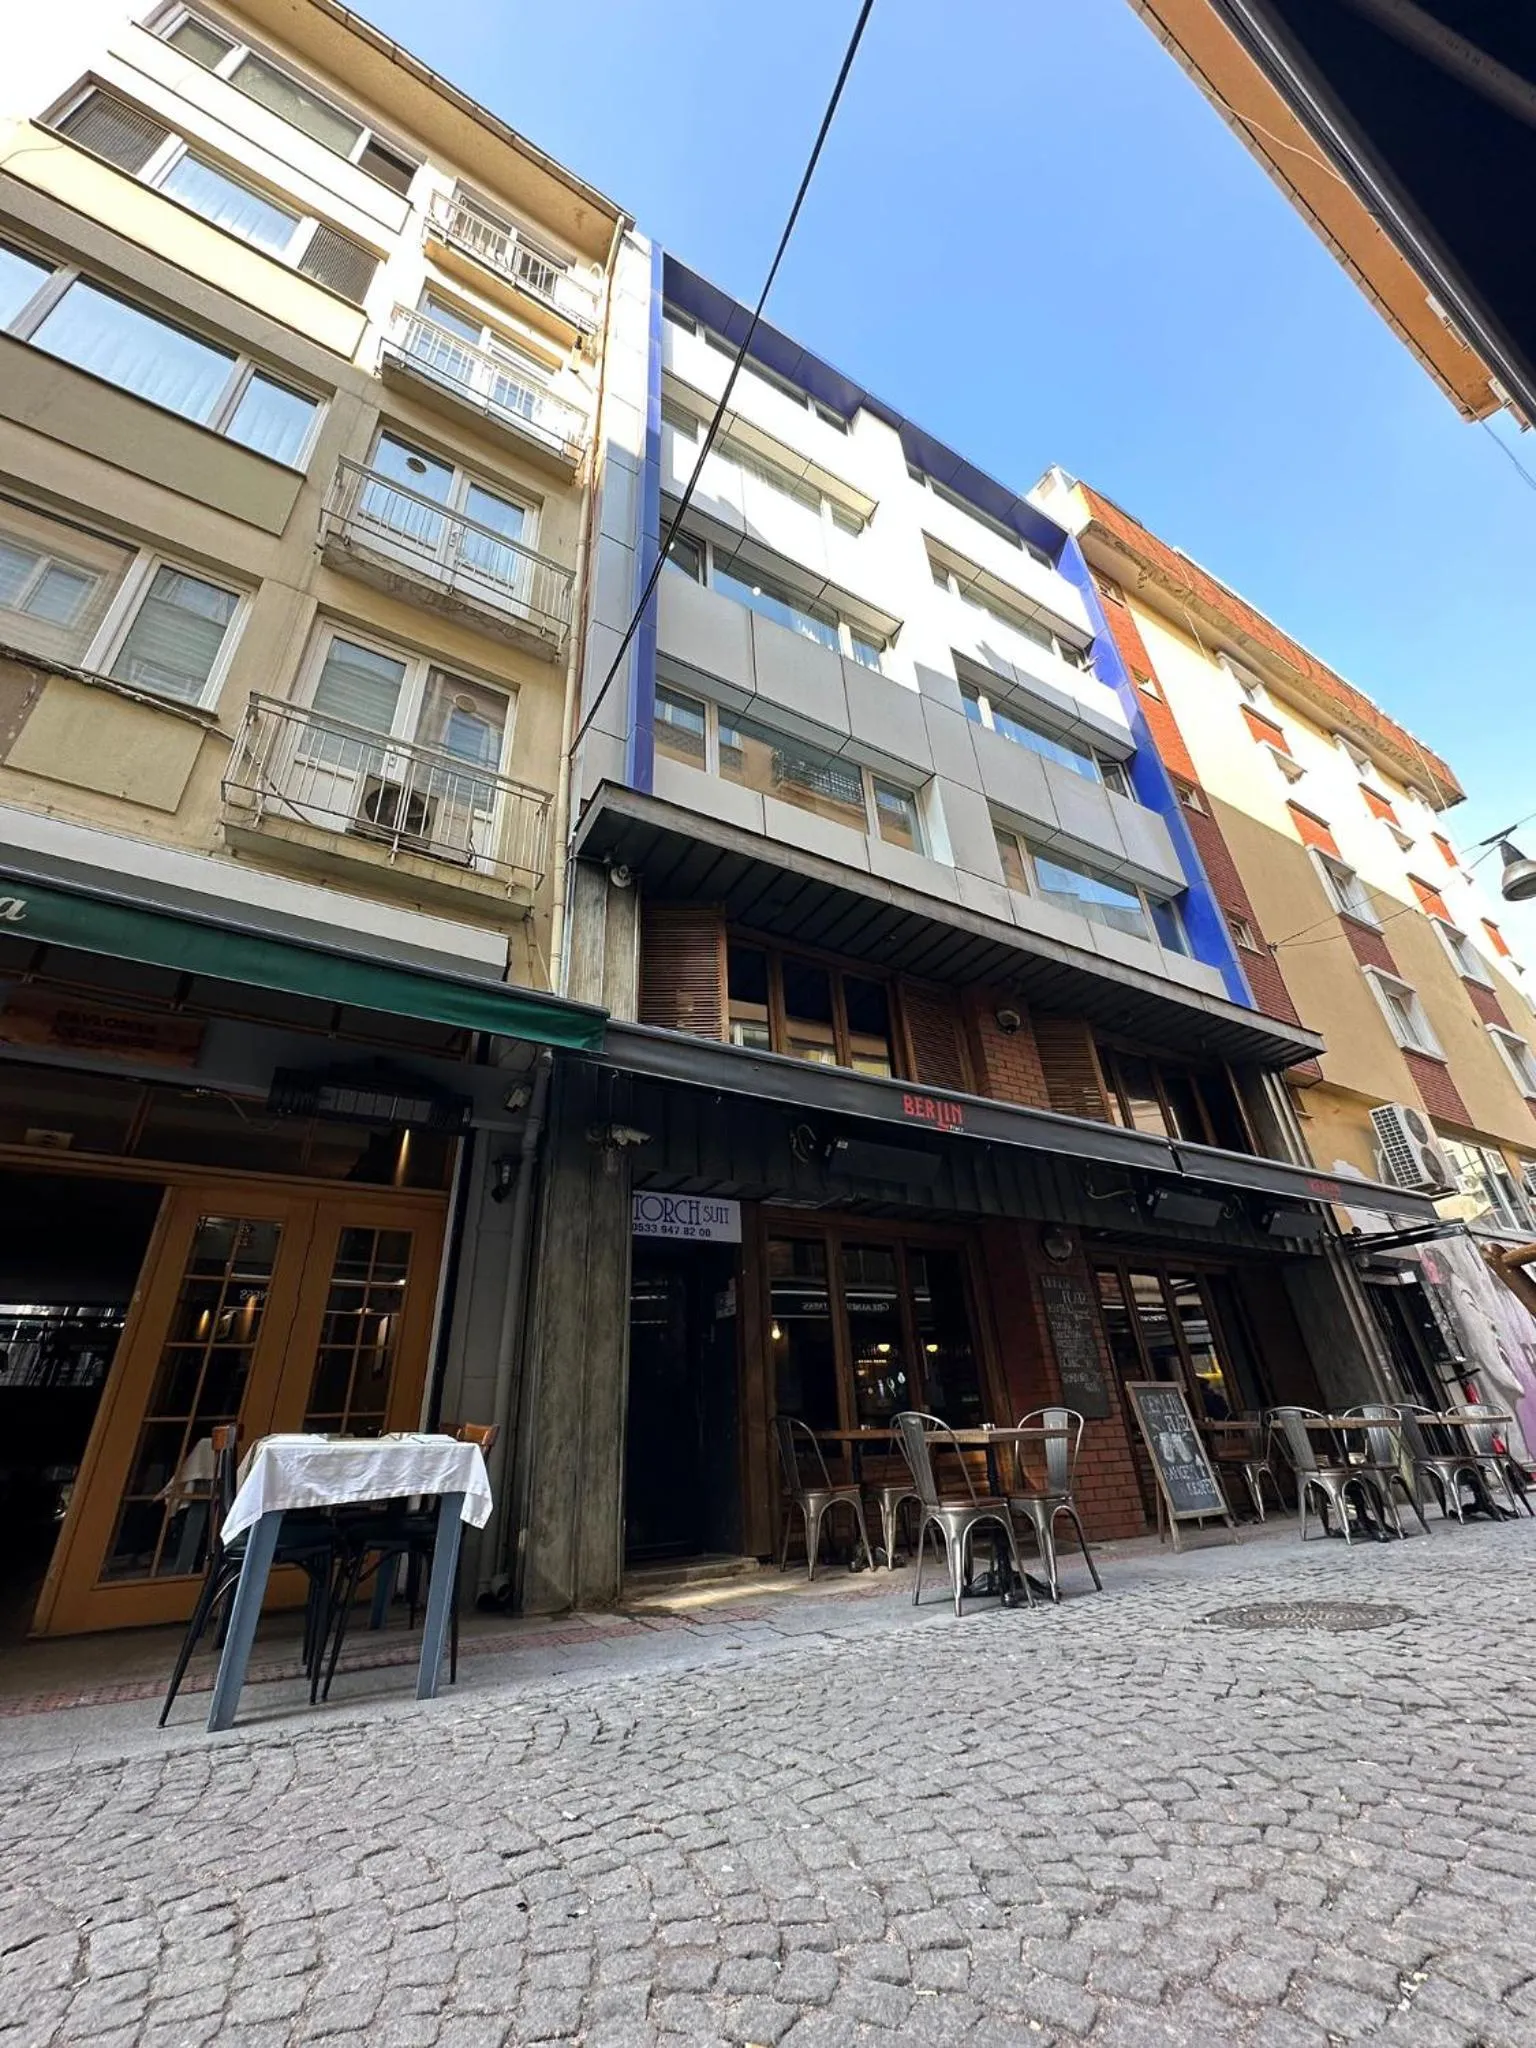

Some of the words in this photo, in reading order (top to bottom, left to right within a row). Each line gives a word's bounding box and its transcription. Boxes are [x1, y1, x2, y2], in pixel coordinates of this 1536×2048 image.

[903, 1092, 963, 1131] BERLIN
[632, 1194, 701, 1226] TORCH
[660, 1225, 680, 1235] 947
